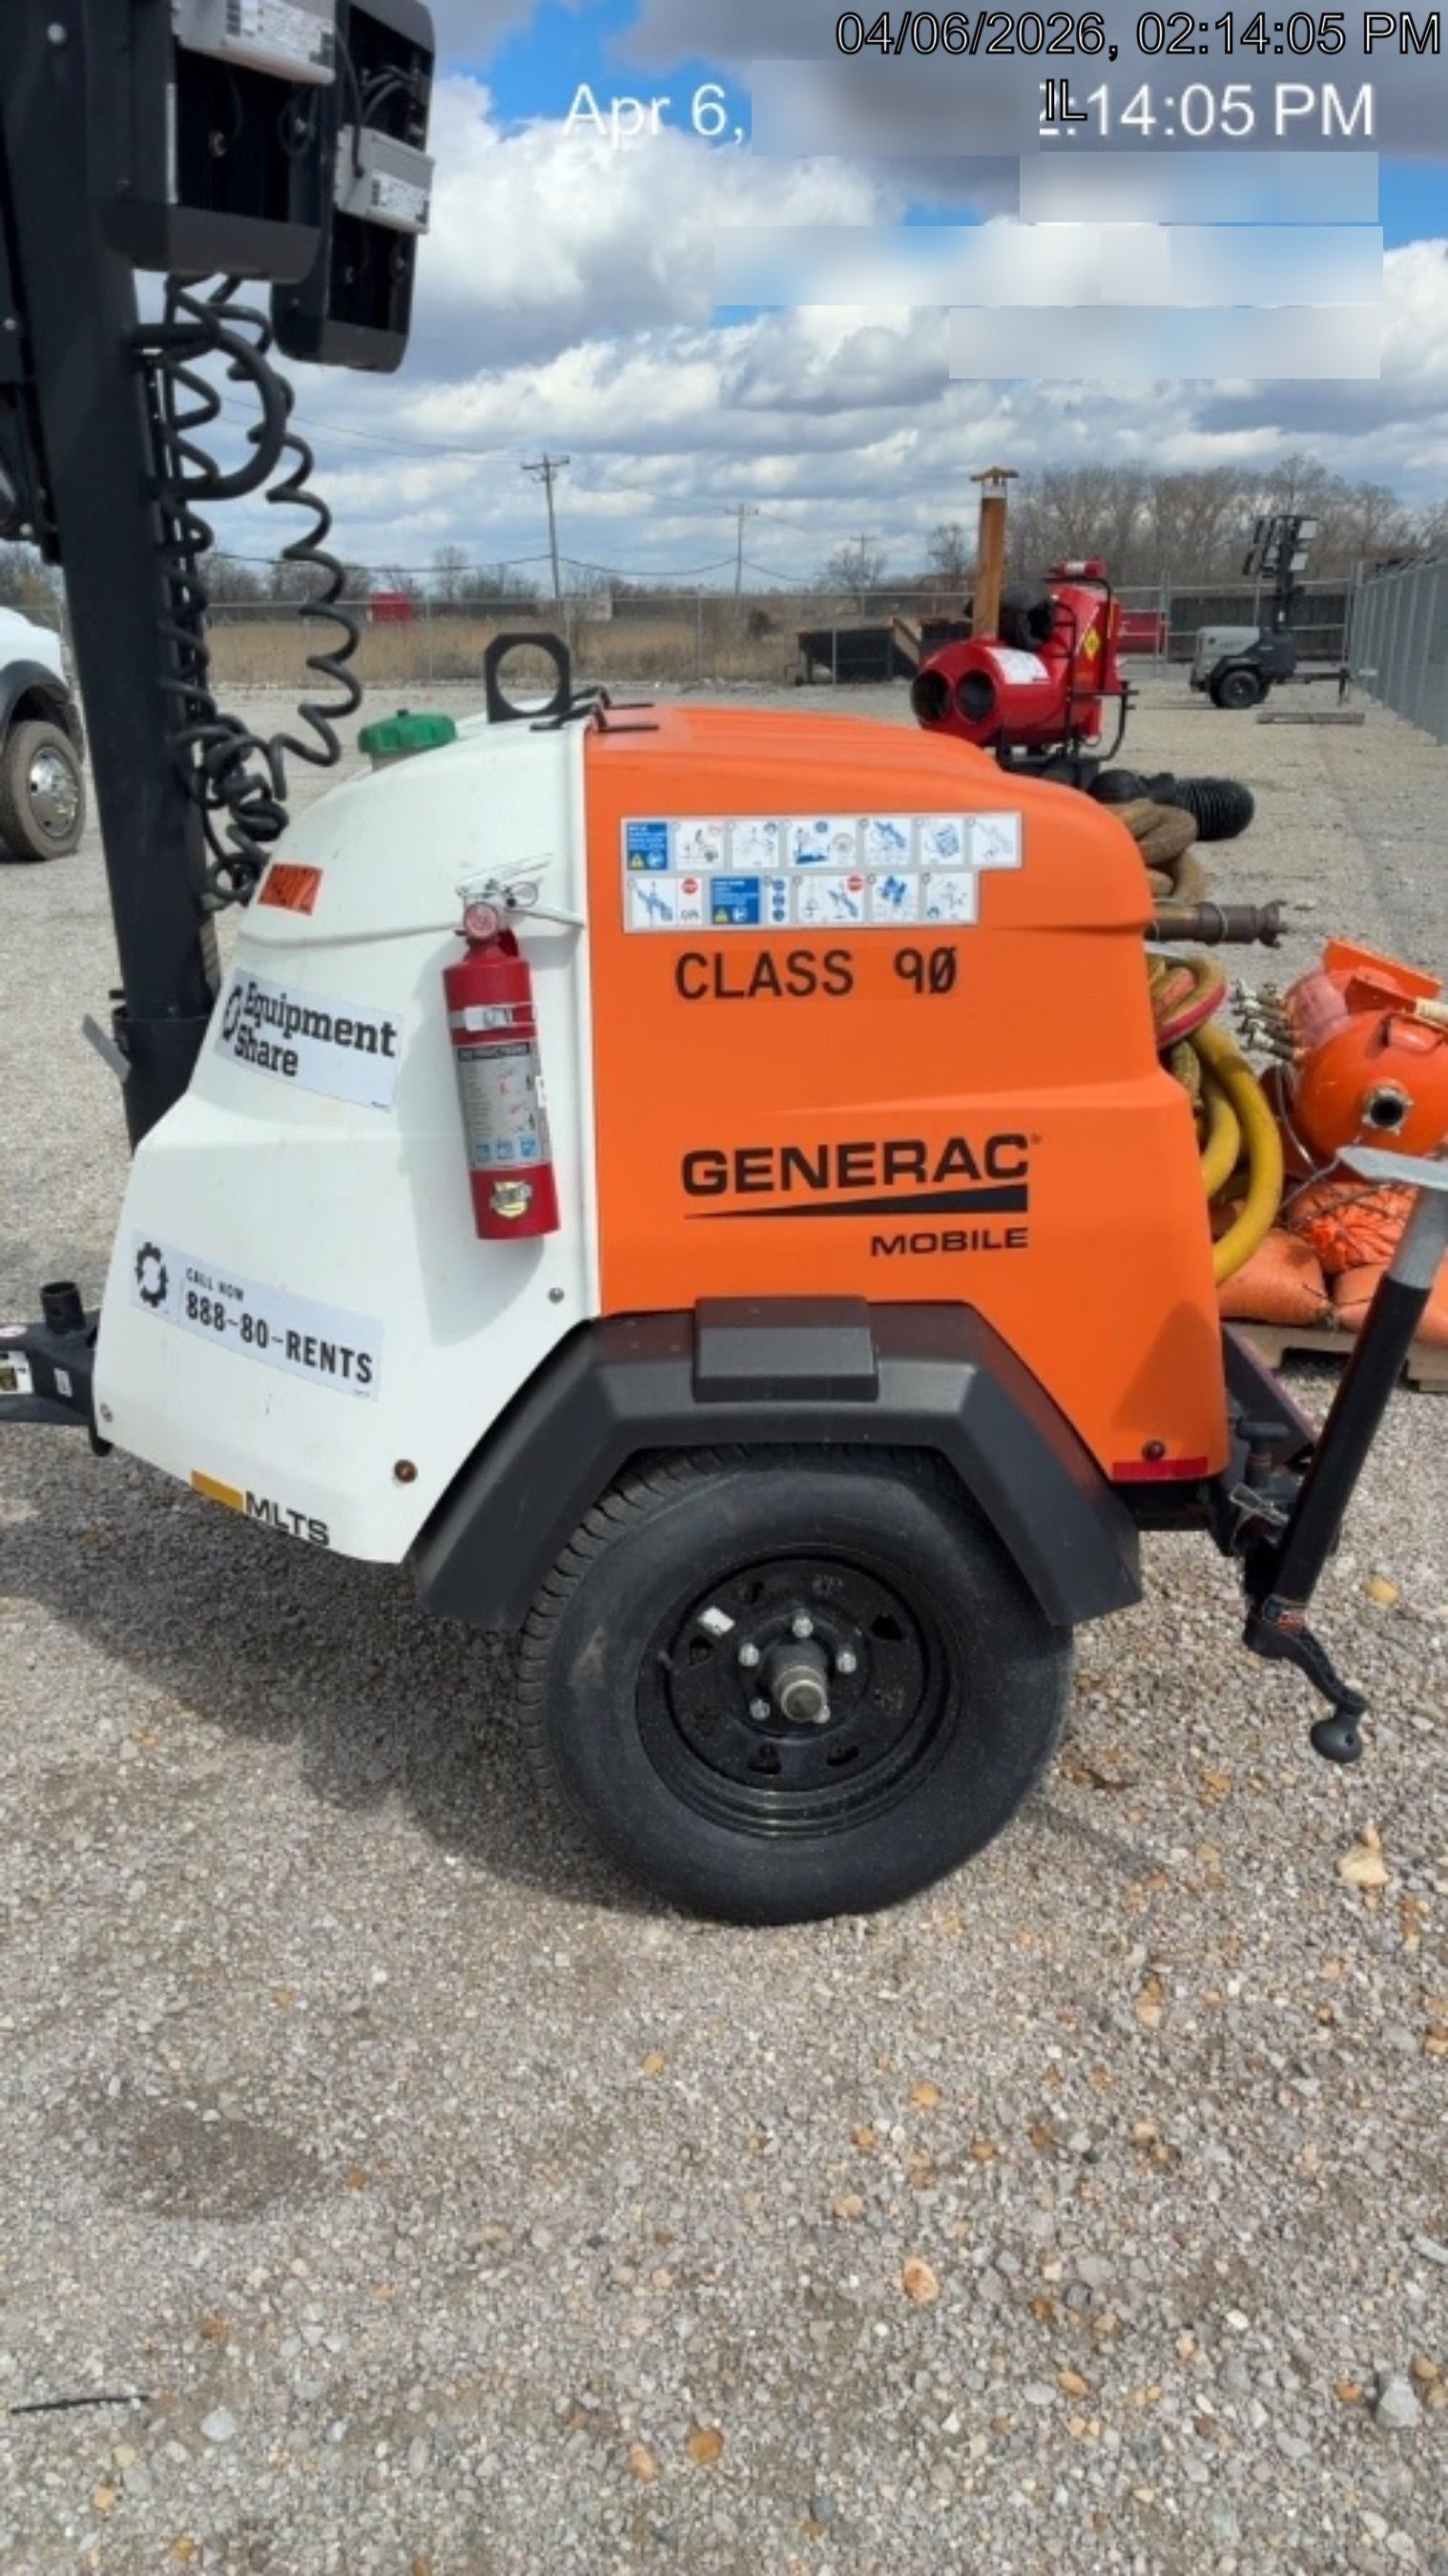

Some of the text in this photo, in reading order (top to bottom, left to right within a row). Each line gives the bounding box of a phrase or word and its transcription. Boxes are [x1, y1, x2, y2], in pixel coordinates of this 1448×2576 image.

[675, 949, 855, 1000] CLASS
[242, 981, 398, 1057] Equipment
[234, 1024, 300, 1077] Share
[681, 1132, 1030, 1196] GENERAC
[869, 1227, 1030, 1257] MOBILE
[186, 1290, 374, 1384] 888-80-RENTS
[245, 1490, 330, 1547] MLTS
